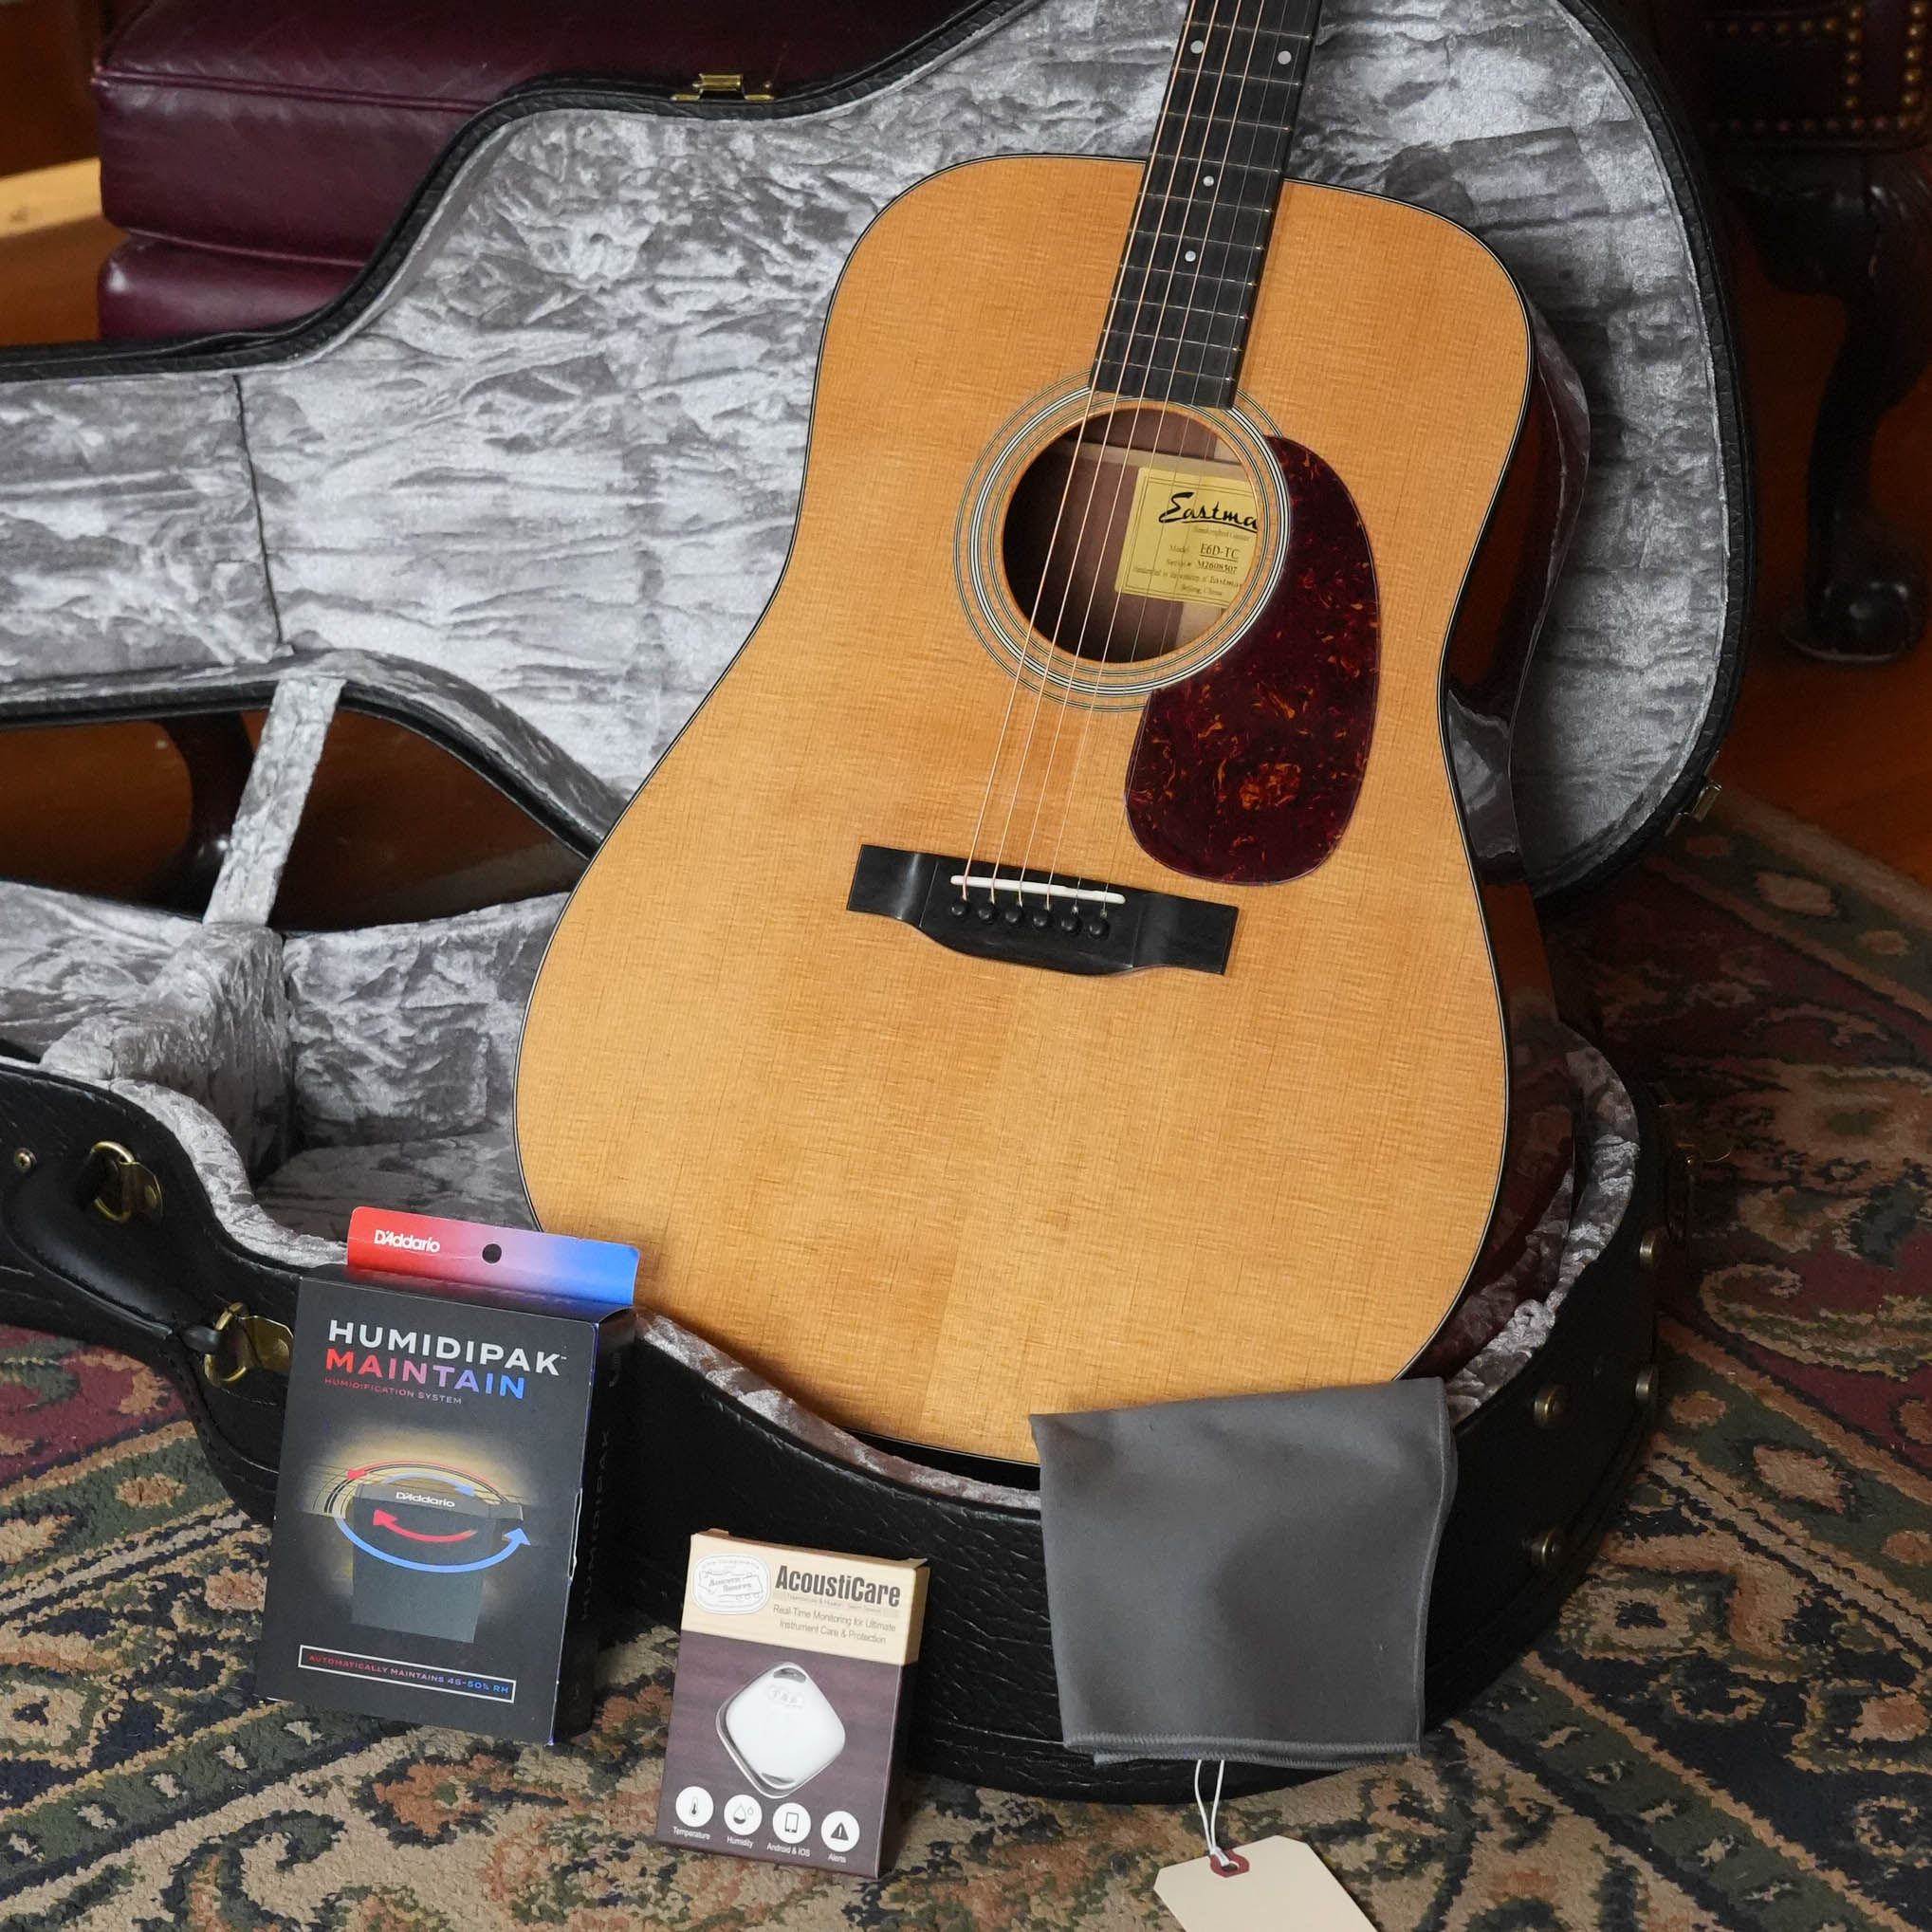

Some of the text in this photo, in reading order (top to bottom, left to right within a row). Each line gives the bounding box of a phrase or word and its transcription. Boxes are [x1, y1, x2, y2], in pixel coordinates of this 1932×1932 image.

[1200, 543, 1241, 560] E6D-TC
[374, 1229, 440, 1253] D'Addario
[325, 1348, 524, 1399] MAINTAIN
[324, 1377, 462, 1405] HUMIDIFICATION SYSTEM
[775, 1565, 901, 1608] AcoustiCare
[780, 1619, 887, 1645] Instrument Care & Protection
[813, 1610, 852, 1627] Monitoring
[854, 1616, 864, 1627] for
[865, 1619, 896, 1632] Ultimate
[308, 1654, 388, 1674] AUTOMATICALLY
[390, 1667, 445, 1684] MAINTAINS
[492, 1684, 509, 1694] RH
[672, 1826, 710, 1841] Temperature
[727, 1835, 754, 1849] Humidity
[766, 1843, 791, 1855] Android
[828, 1852, 846, 1864] Alerts
